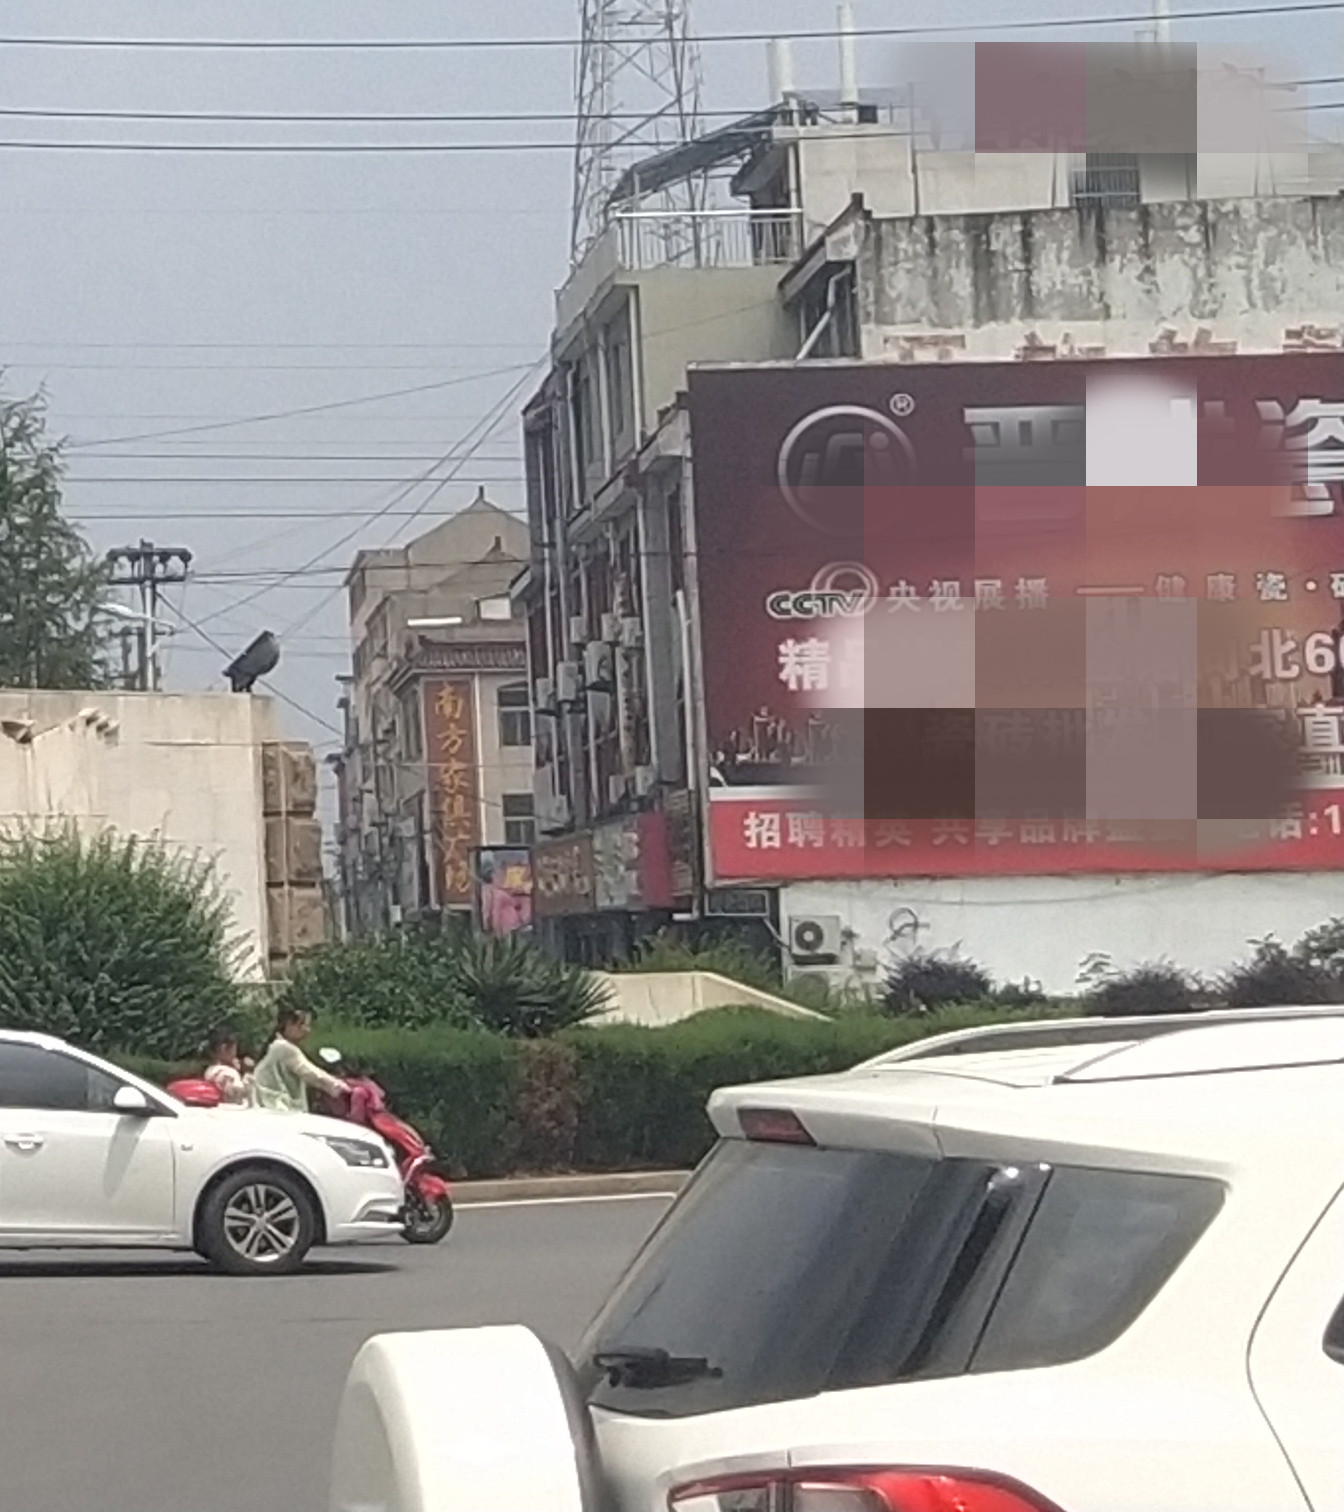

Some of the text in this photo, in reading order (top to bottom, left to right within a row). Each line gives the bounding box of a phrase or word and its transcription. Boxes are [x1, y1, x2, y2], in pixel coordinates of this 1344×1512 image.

[767, 589, 865, 619] CCTV
[887, 577, 1049, 614] 央视展播
